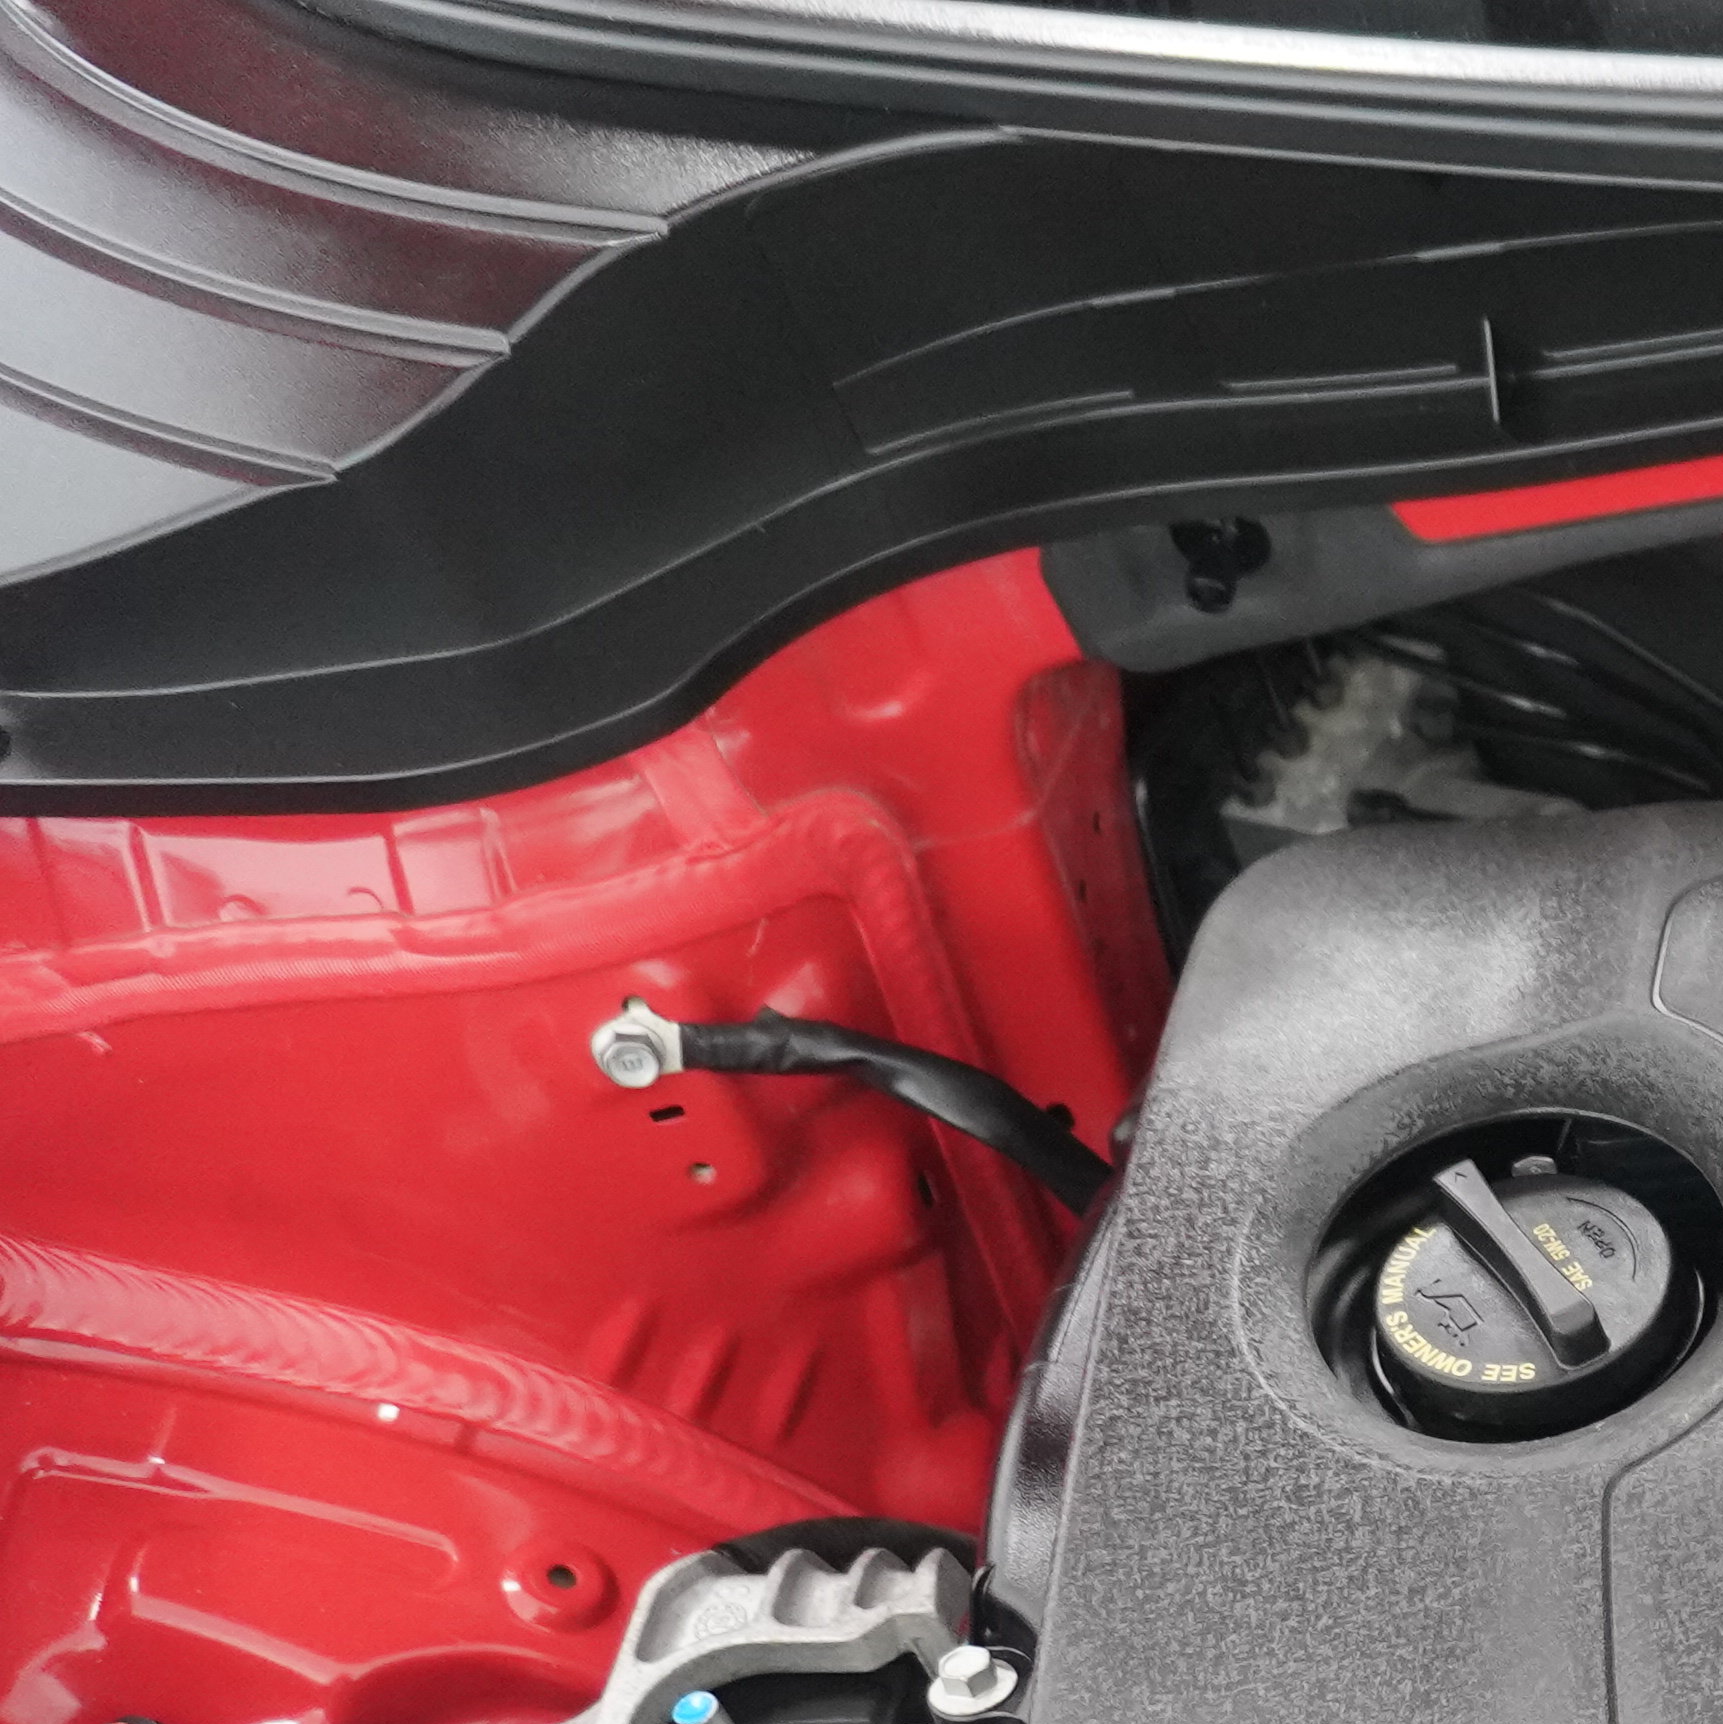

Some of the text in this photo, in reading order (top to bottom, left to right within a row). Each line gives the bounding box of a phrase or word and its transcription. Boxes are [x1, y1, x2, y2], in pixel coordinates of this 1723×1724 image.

[1532, 1221, 1593, 1292] SAE 5W-20
[1577, 1219, 1616, 1261] OPEN
[1380, 1225, 1537, 1382] SEE OWNER'S MANUAL
